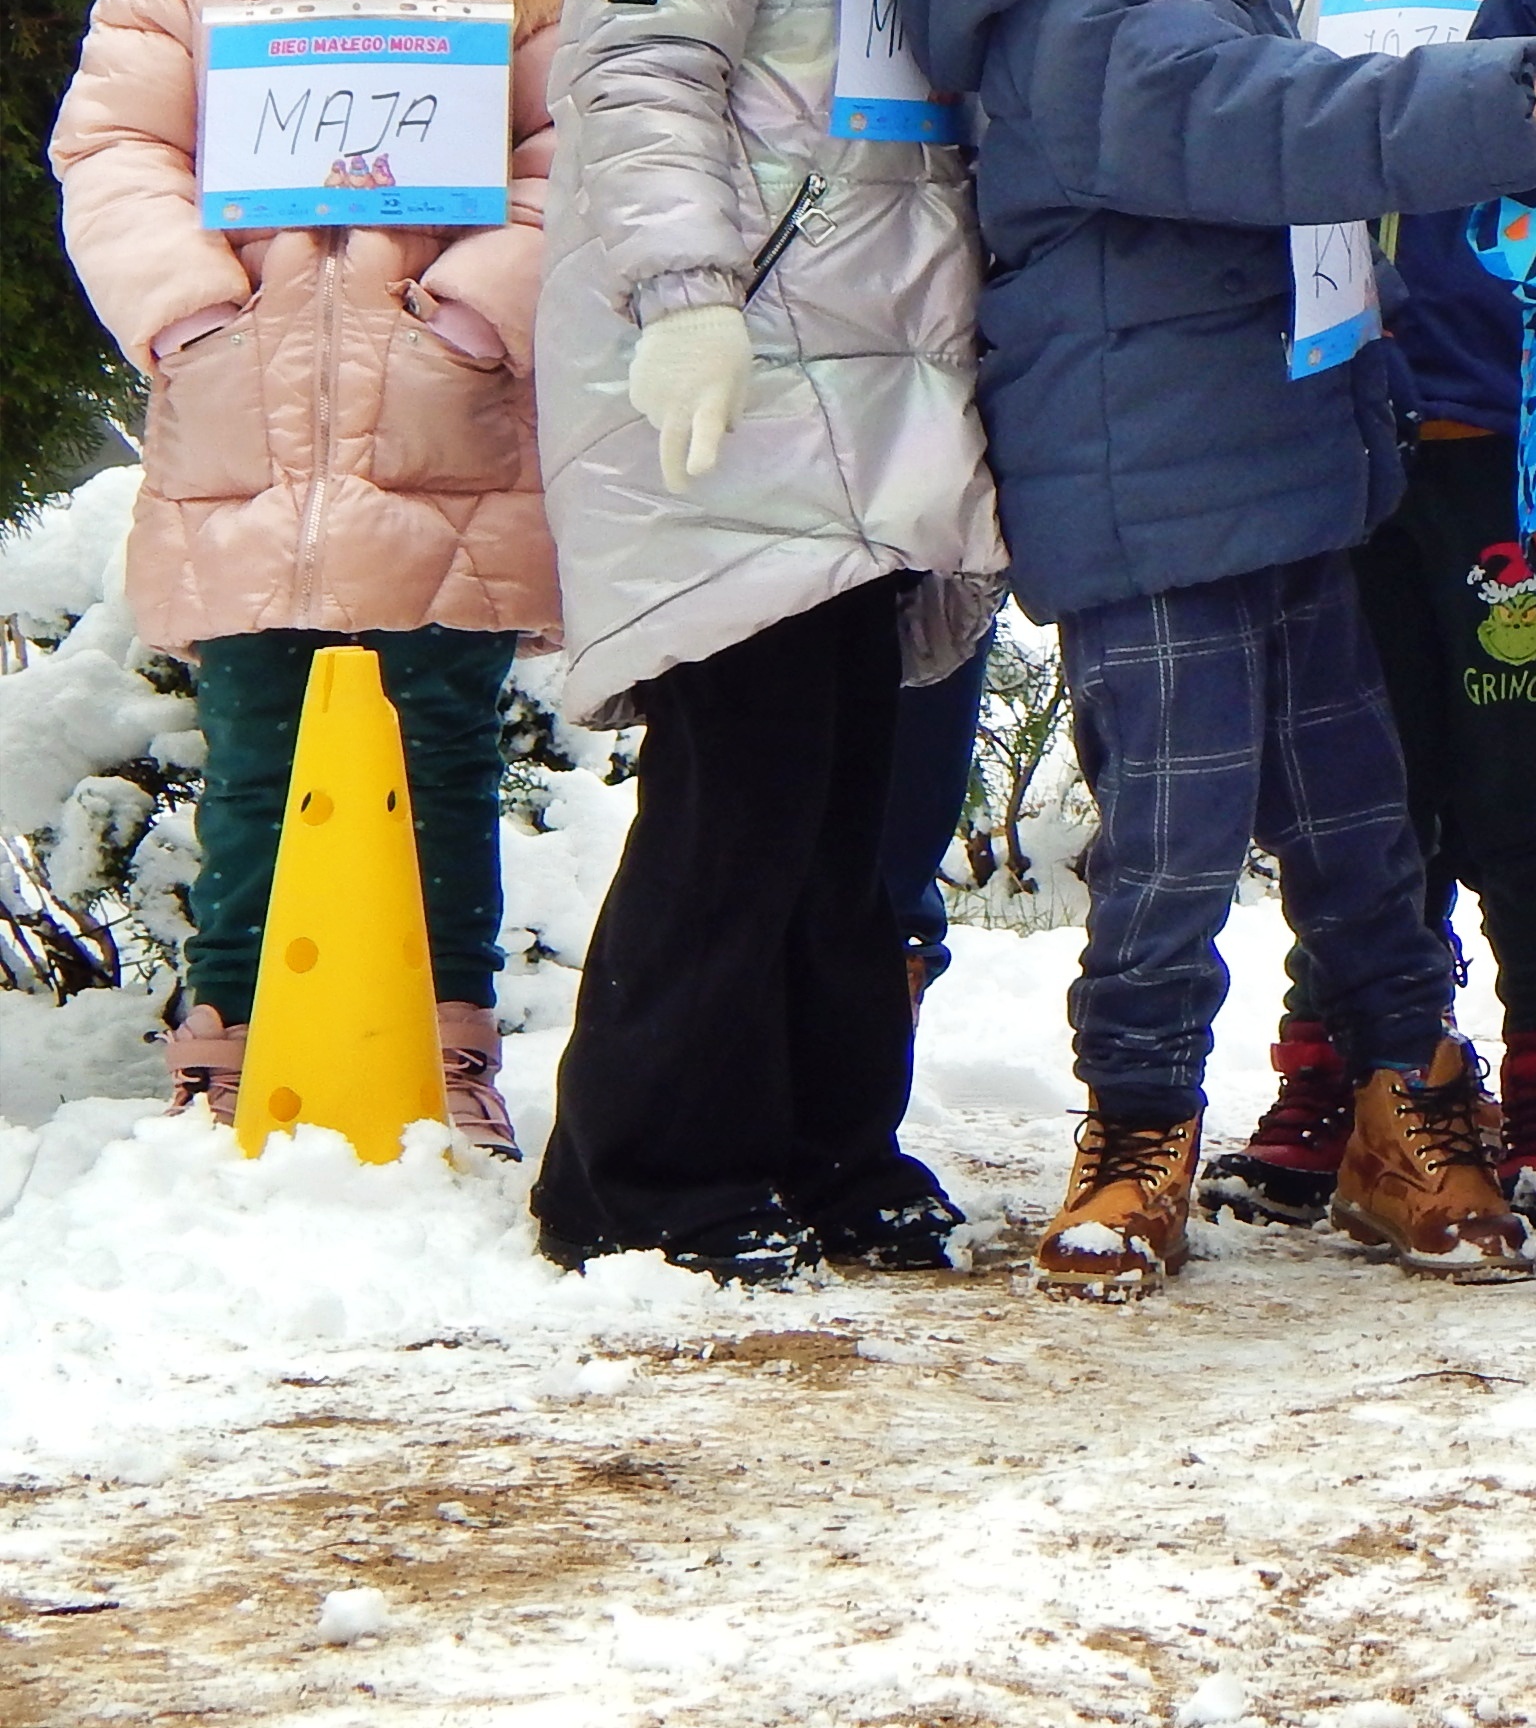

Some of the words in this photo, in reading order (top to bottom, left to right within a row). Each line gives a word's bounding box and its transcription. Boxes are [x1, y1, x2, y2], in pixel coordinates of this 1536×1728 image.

[268, 39, 307, 56] BIEG
[311, 36, 384, 55] MAŁEGO
[388, 35, 451, 53] MORSA
[253, 87, 438, 159] MAJA
